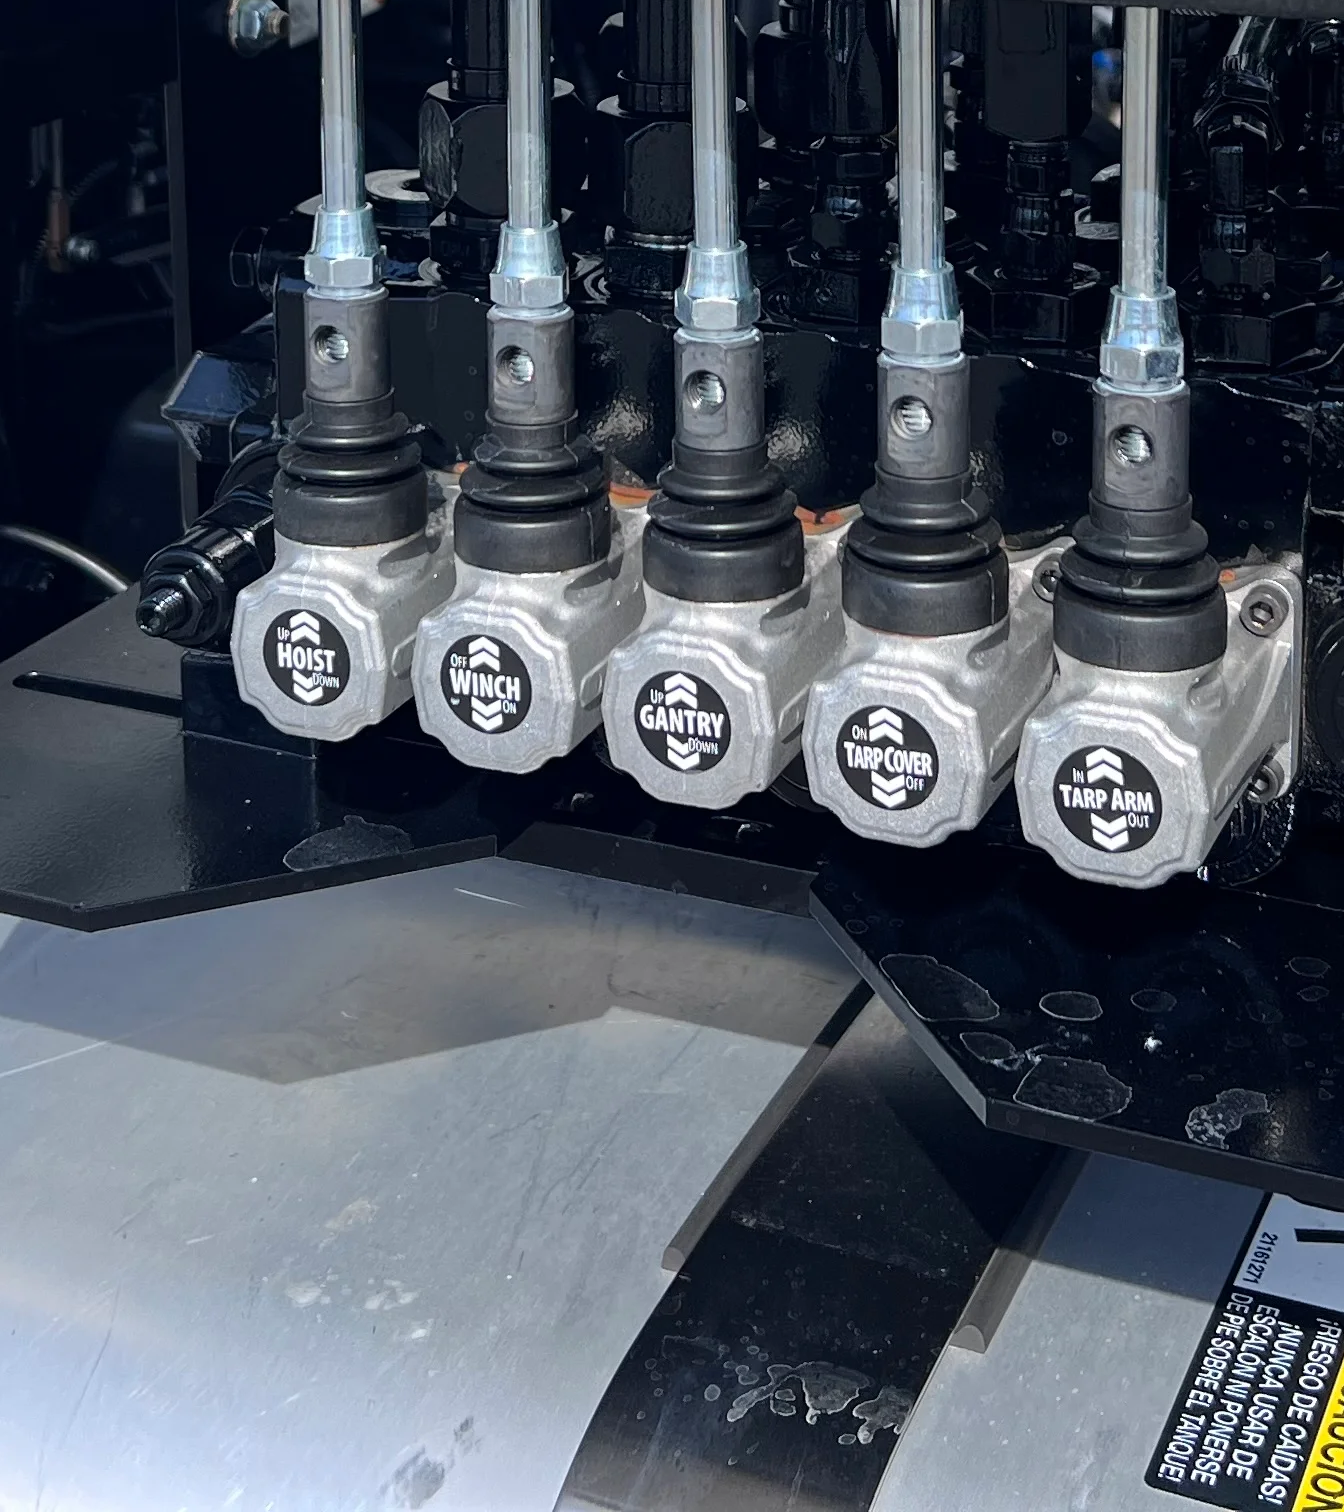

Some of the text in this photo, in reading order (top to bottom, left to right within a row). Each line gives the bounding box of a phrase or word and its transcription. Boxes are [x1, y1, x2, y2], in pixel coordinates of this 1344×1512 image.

[276, 626, 290, 640] UP
[276, 642, 336, 673] HOIST
[449, 652, 468, 669] OFF
[312, 672, 340, 689] DOWN
[449, 667, 521, 702] WINCH
[649, 688, 664, 704] UP
[502, 699, 517, 714] ON
[639, 704, 725, 738] GANTRY
[687, 737, 719, 755] DOWN
[851, 724, 868, 741] ON
[843, 740, 933, 777] TARP COVER
[905, 775, 925, 792] OFF
[1072, 767, 1085, 784] IN
[1058, 783, 1155, 814] TARP ARM
[1127, 812, 1150, 829] OUT
[1242, 1230, 1279, 1285] 21161271
[1157, 1292, 1254, 1483] DE PIE SOBRE EL TANQUE!
[1190, 1304, 1280, 1486] ESCALÓN NI PONERSE
[1238, 1393, 1279, 1447] USAR
[1286, 1392, 1318, 1423] DE
[1226, 1448, 1258, 1481] DE
[1258, 1423, 1307, 1506] CAÍDAS!
